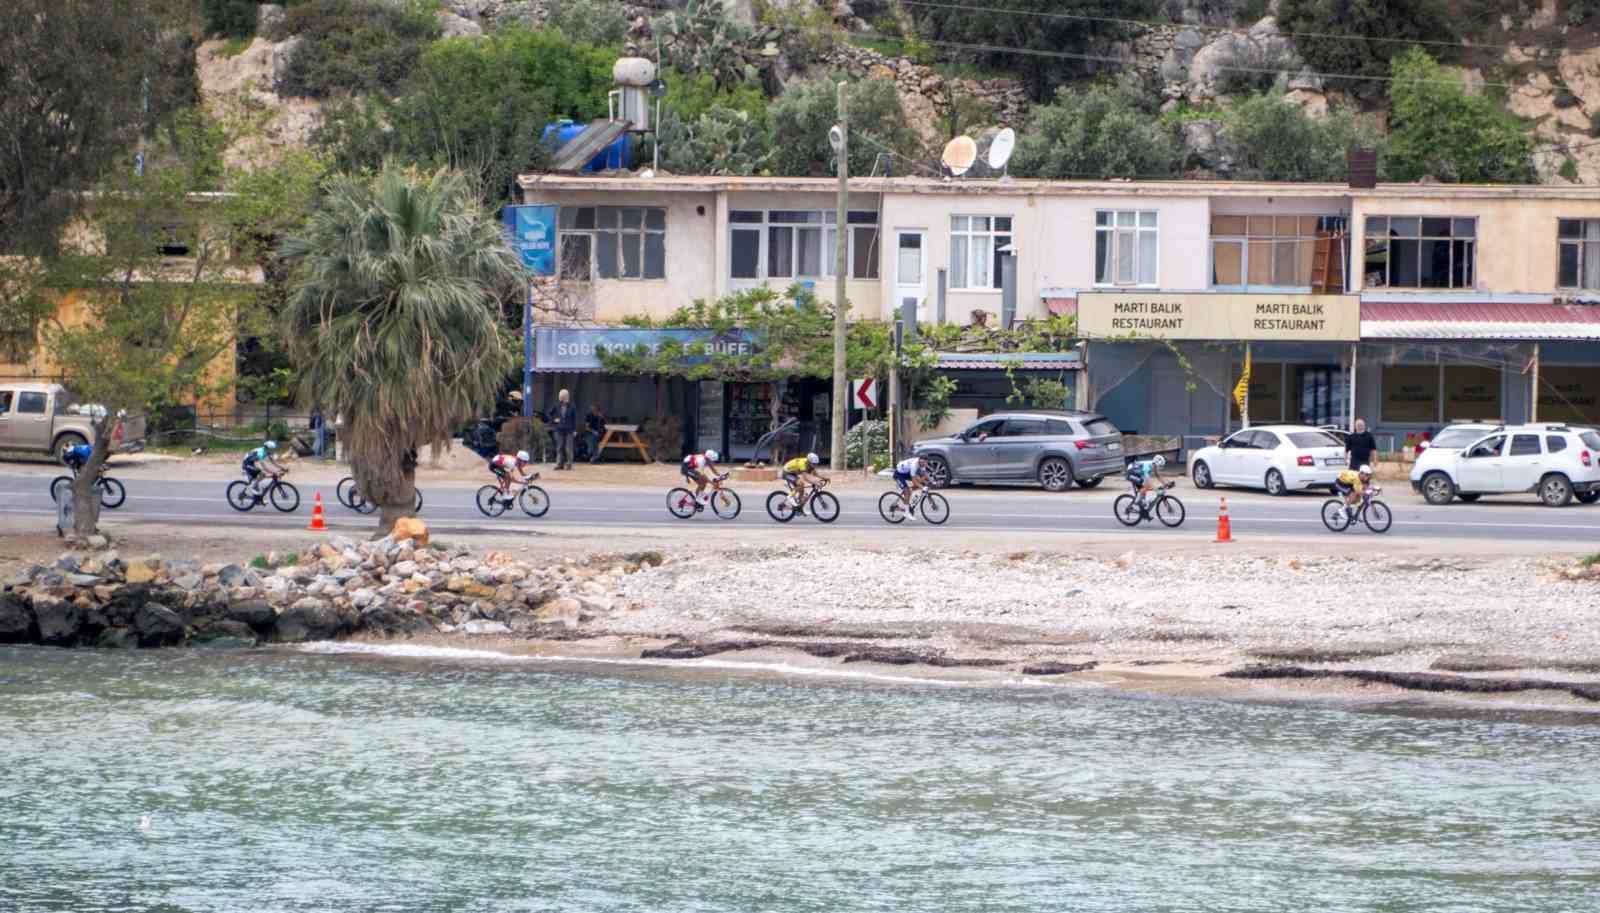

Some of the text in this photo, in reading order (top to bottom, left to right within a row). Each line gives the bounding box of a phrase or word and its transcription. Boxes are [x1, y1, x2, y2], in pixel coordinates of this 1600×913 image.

[1114, 302, 1182, 313] MARTI BALIK
[1256, 303, 1322, 315] MARTI BALIK
[1112, 318, 1183, 329] RESTAURANT
[1254, 319, 1325, 330] RESTAURANT
